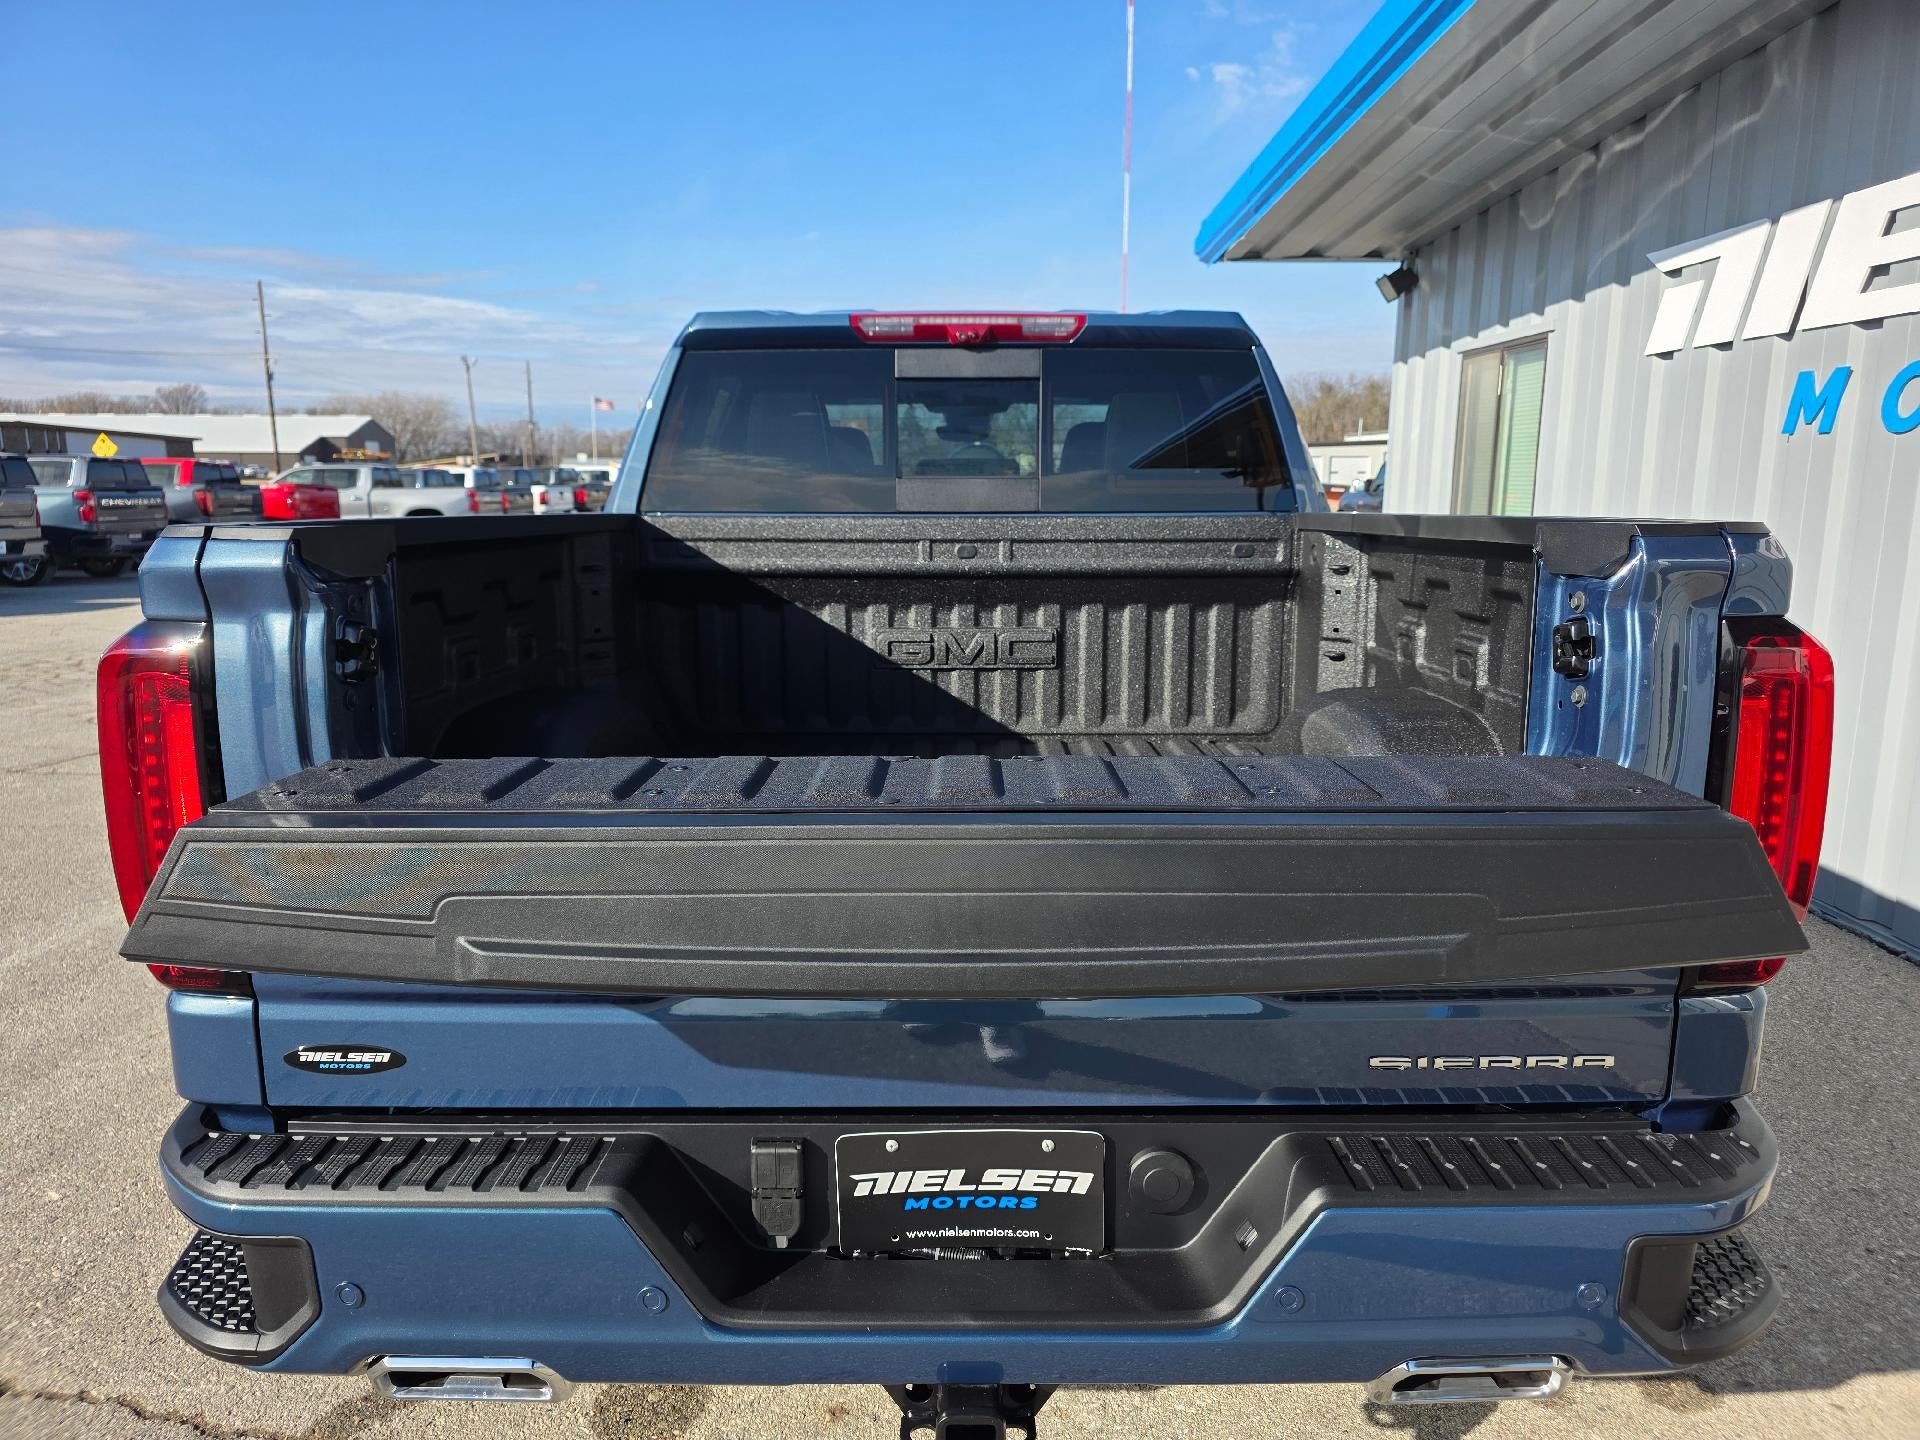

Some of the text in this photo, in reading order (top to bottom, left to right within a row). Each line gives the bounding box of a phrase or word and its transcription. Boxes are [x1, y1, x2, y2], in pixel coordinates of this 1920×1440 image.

[876, 630, 1057, 668] GMC
[298, 1051, 391, 1063] NIELSEN
[1369, 1055, 1615, 1071] SIERRA
[850, 1168, 1094, 1197] NIELSEN
[904, 1196, 1039, 1211] MOTORS
[906, 1225, 1040, 1239] www.nielsenmotors.com
